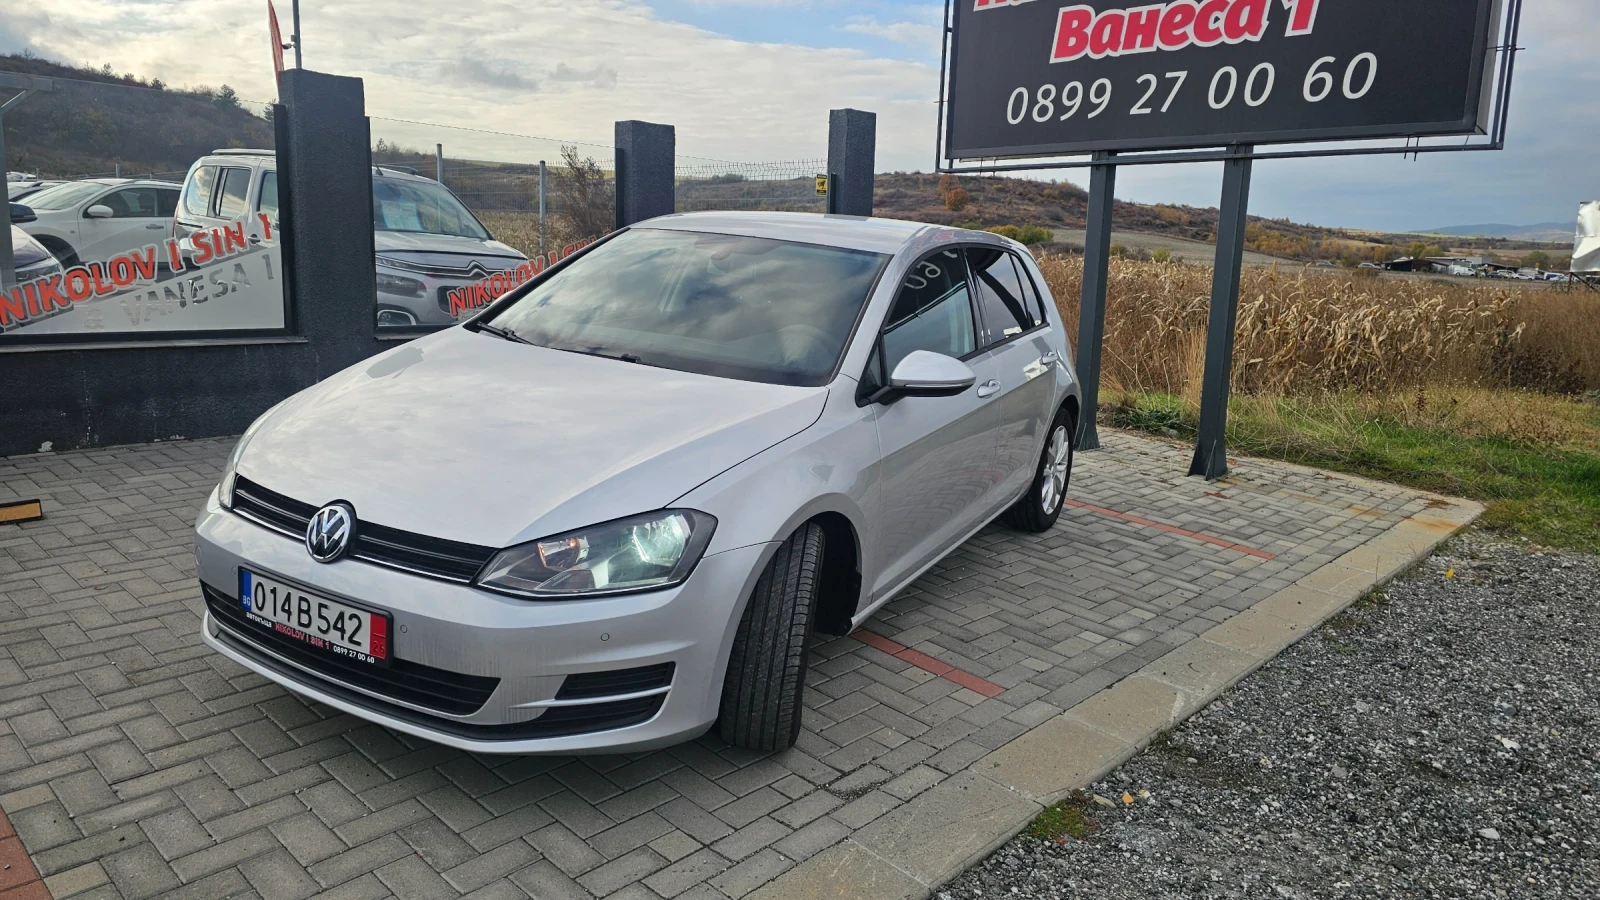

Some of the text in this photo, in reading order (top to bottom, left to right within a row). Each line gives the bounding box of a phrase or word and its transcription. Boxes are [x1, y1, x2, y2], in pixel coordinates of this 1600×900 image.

[1050, 0, 1269, 63] Ванеса
[1006, 52, 1378, 125] 0899 27 00 60
[0, 212, 274, 327] NIKOLOV I SIN 1
[119, 262, 252, 327] VANESA
[260, 253, 275, 281] 1
[242, 581, 362, 647] BG 014B542
[275, 622, 305, 640] NIKOLOV
[333, 645, 348, 655] 0899
[349, 650, 357, 658] 27
[357, 653, 366, 661] 00
